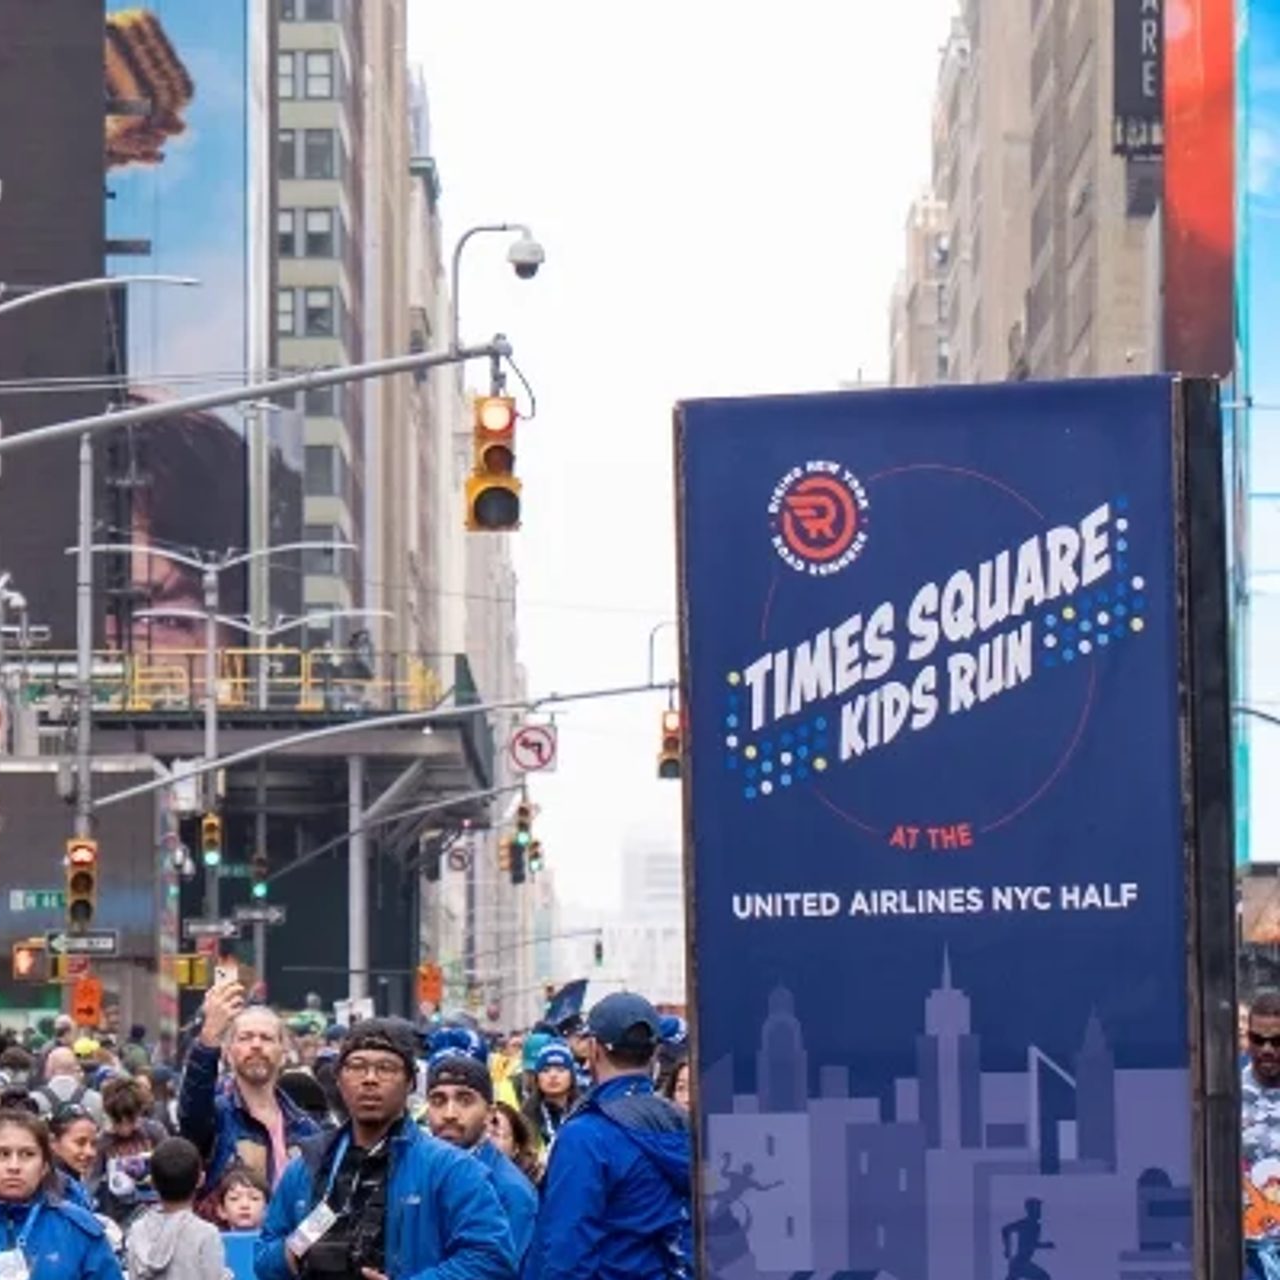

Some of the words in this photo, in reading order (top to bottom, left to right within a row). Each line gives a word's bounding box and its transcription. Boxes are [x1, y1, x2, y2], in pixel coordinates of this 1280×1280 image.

[806, 461, 839, 475] NEW
[743, 603, 896, 732] TIMES
[907, 502, 1112, 662] SQUARE
[840, 665, 939, 761] KIDS
[947, 621, 1033, 714] RUN
[890, 826, 919, 849] AT
[926, 823, 973, 848] THE
[732, 892, 841, 919] UNITED
[849, 886, 984, 916] AIRLINES
[992, 885, 1052, 911] NYC
[1060, 882, 1138, 910] HALF
